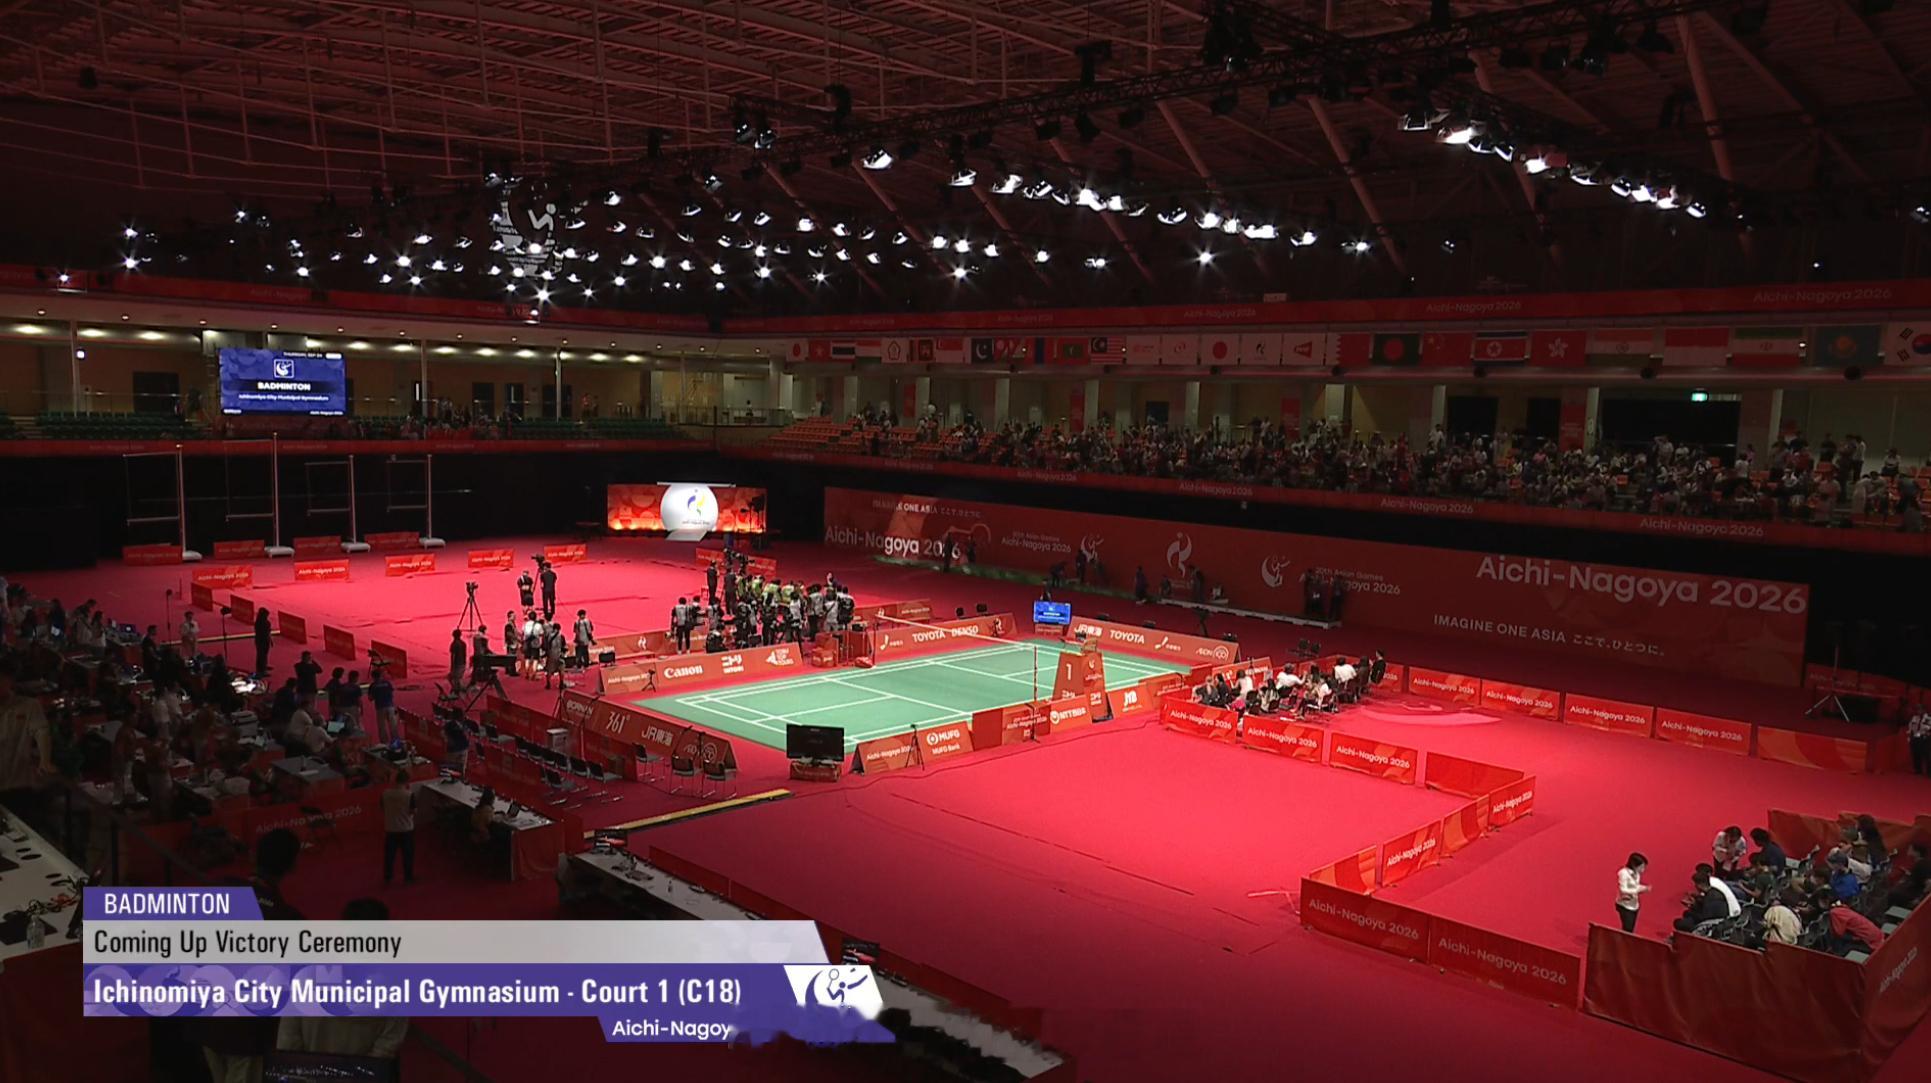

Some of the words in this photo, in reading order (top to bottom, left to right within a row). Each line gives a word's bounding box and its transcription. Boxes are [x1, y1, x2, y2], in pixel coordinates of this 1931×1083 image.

[1855, 288, 1891, 300] 2026
[257, 382, 311, 391] BADMINTON
[904, 503, 920, 512] ONE
[1449, 503, 1474, 514] 2026
[1640, 518, 1728, 536] Aichi-Nagoya
[1730, 524, 1764, 536] 2026
[825, 526, 920, 558] Aichi-Nagoya
[924, 538, 961, 560] 206
[1052, 542, 1072, 552] 2026
[1373, 582, 1400, 595] 2026
[1476, 555, 1699, 606] Aichi-Nagoya
[1710, 580, 1807, 614] 2026
[912, 630, 946, 643] TOYOTA
[951, 625, 979, 637] DENSO
[1110, 628, 1145, 644] TOYOTA
[1433, 614, 1493, 633] IMAGINE
[1496, 622, 1528, 638] ONE
[1531, 628, 1566, 643] ASIA
[664, 665, 704, 679] Canon
[1066, 663, 1072, 681] 1
[1413, 678, 1458, 691] Aichi-Nagoya
[1458, 685, 1474, 695] 2026
[1486, 690, 1533, 706] Aichi-Nagoya
[1534, 699, 1552, 708] 2026
[1170, 710, 1214, 726] Aichi-Nagoya
[1216, 720, 1232, 730] 2026
[1570, 705, 1623, 721] Aichi-Nagoya
[1625, 714, 1646, 724] 2026
[938, 730, 960, 740] MUFG
[1248, 727, 1298, 744] Aichi-Nagoya
[1298, 738, 1318, 748] 2026
[1662, 720, 1718, 737] Aichi-Nagoya
[1720, 730, 1742, 741] 2026
[867, 749, 900, 760] Aichi-Nagoya
[1336, 746, 1389, 764] Aichi-Nagoya
[1390, 756, 1410, 769] 2026
[1308, 898, 1386, 932] Aichi-Nagoya
[1389, 922, 1420, 940] 2026
[1439, 937, 1528, 974] Aichi-Nagoya
[1532, 962, 1568, 986] 2026
